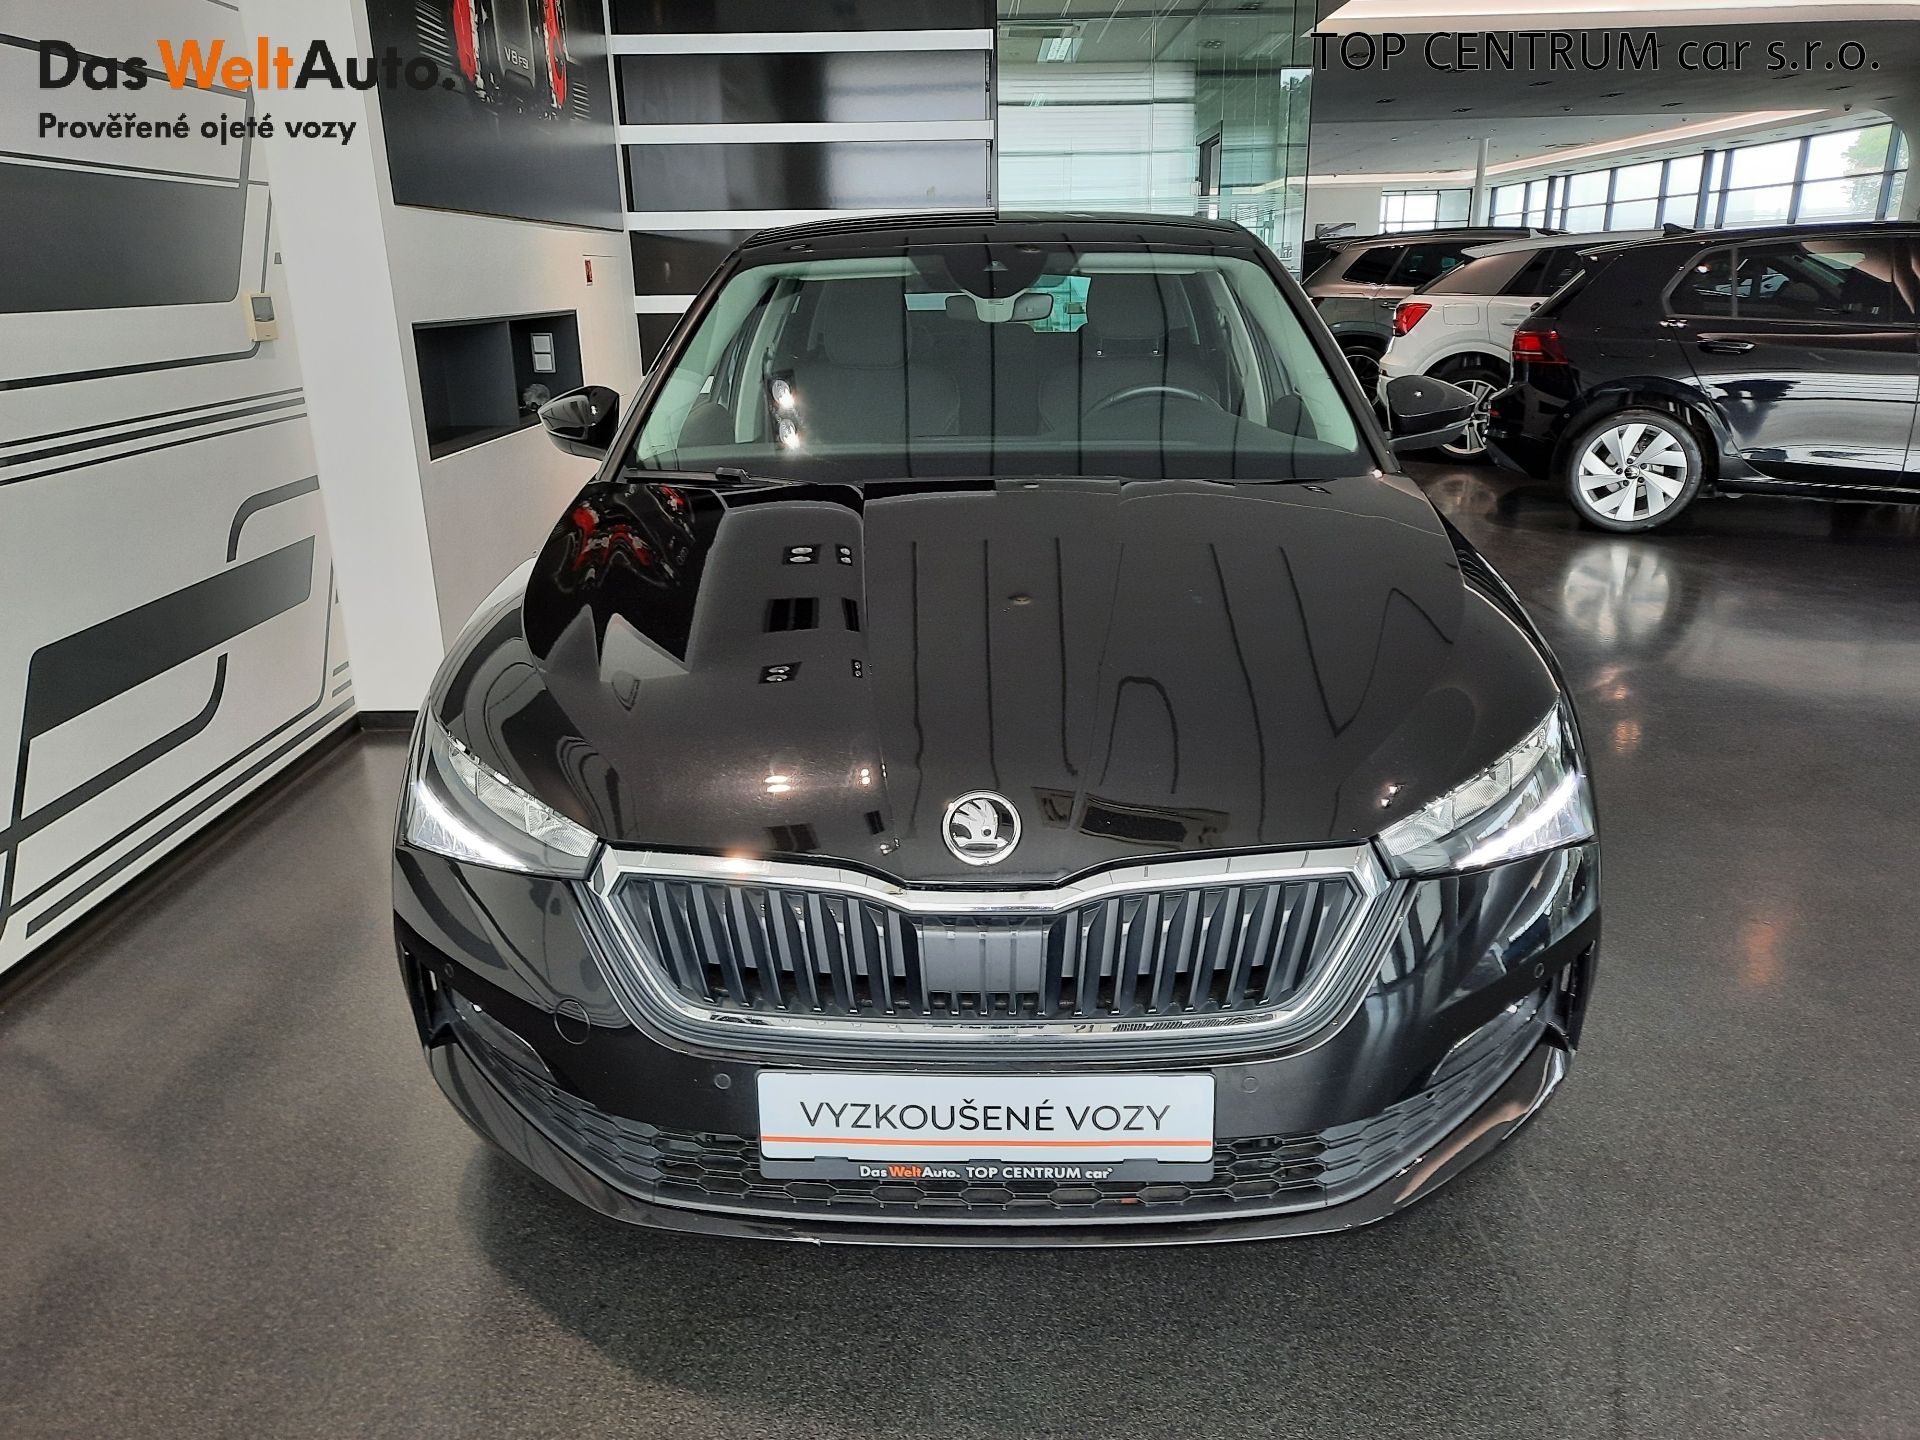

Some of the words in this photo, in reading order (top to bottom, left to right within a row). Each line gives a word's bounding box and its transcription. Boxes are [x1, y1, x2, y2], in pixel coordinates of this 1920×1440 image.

[800, 1099, 1055, 1131] VYZKOUŠENÉ
[1065, 1105, 1171, 1131] VOZY
[860, 1165, 887, 1177] Das
[966, 1166, 998, 1178] TOP
[1002, 1167, 1081, 1179] CENTRUM
